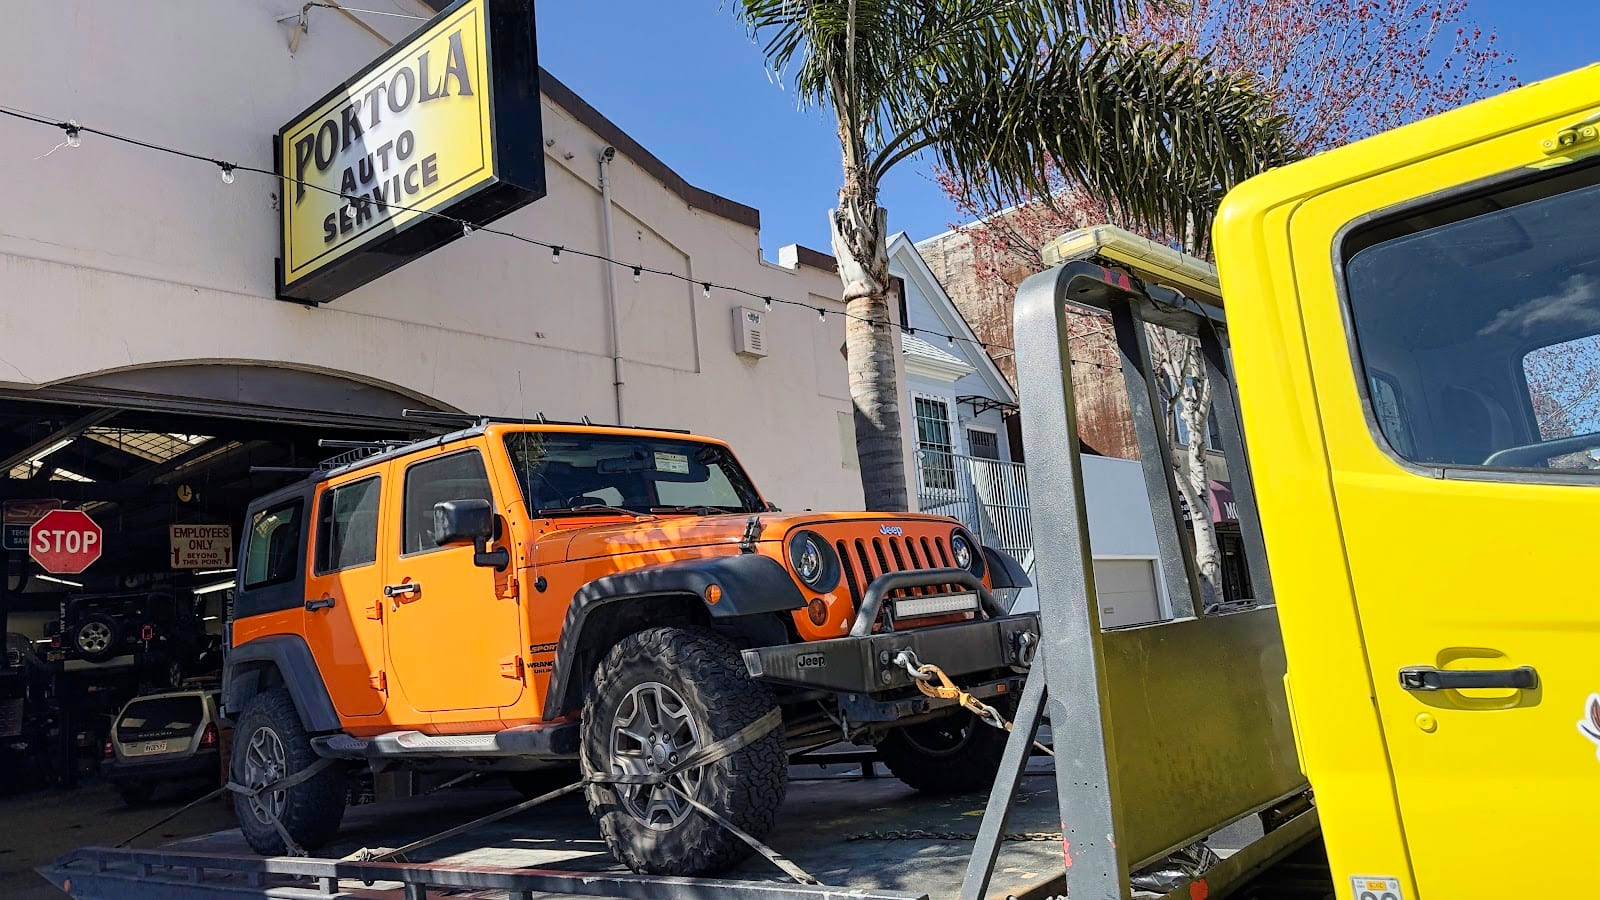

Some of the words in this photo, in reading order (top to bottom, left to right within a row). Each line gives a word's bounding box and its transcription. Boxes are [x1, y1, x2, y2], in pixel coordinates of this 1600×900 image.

[294, 28, 474, 205] PORTOLA
[339, 129, 415, 199] AUTO
[323, 153, 439, 244] SERVICE
[173, 527, 229, 538] EMPLOYEES
[880, 523, 903, 537] Jeep
[35, 529, 98, 554] STOP
[188, 539, 214, 550] ONLY
[798, 655, 825, 667] Jeep
